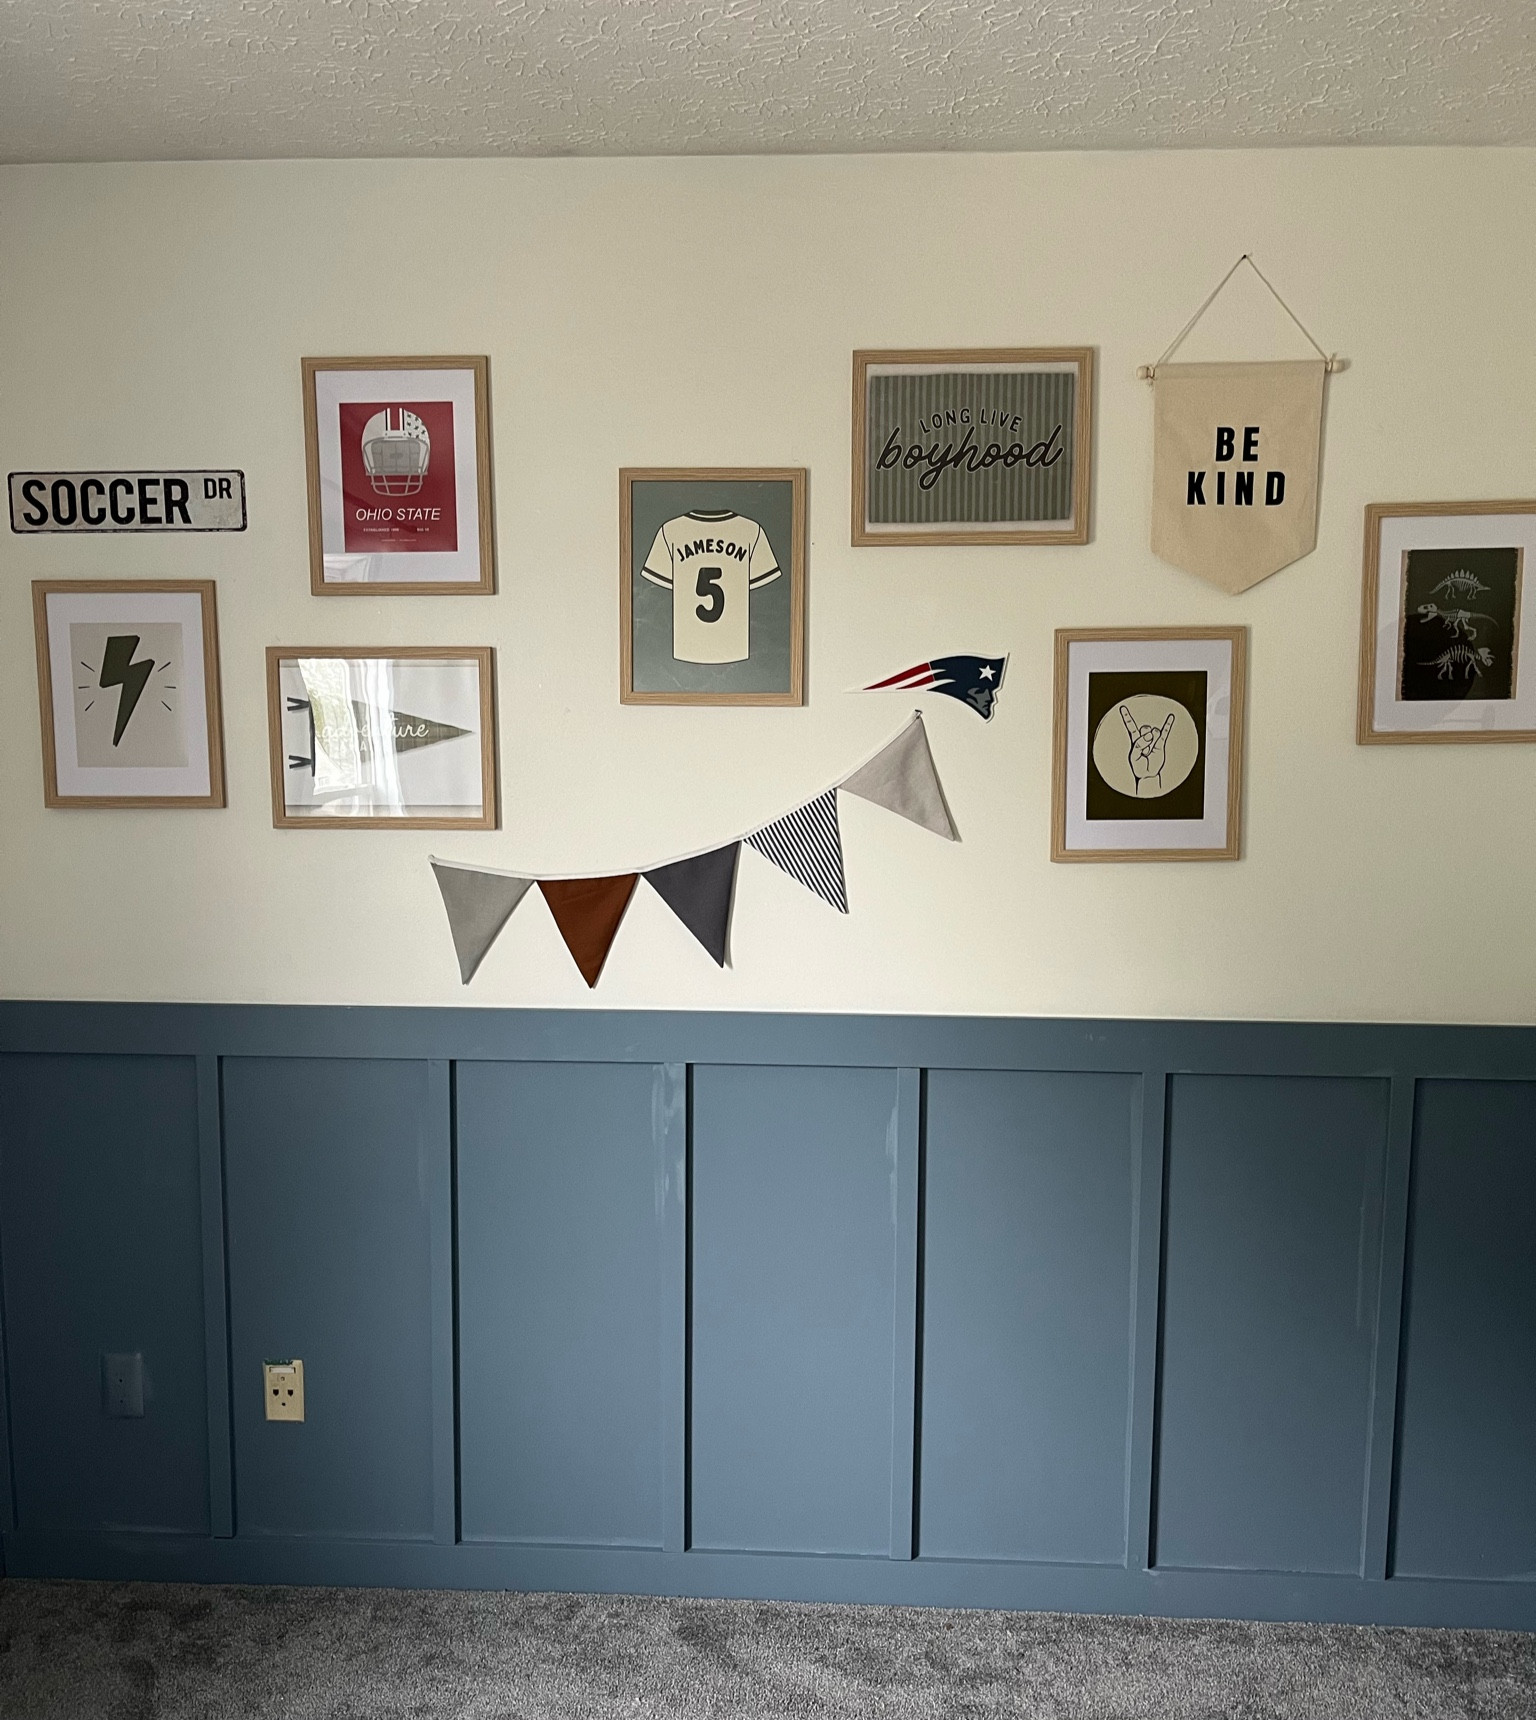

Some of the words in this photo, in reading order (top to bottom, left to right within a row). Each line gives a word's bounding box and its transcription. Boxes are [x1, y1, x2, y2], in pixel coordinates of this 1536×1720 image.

[919, 408, 970, 433] LONG
[979, 408, 1022, 433] LIVE
[875, 424, 1064, 491] boyhood
[1215, 426, 1260, 462] BE
[21, 478, 192, 526] SOCCER
[203, 477, 233, 499] DR
[1186, 471, 1286, 506] KIND
[355, 508, 393, 521] OHIO
[396, 507, 441, 521] STATE
[676, 538, 748, 562] JAMESON
[695, 567, 725, 623] 5
